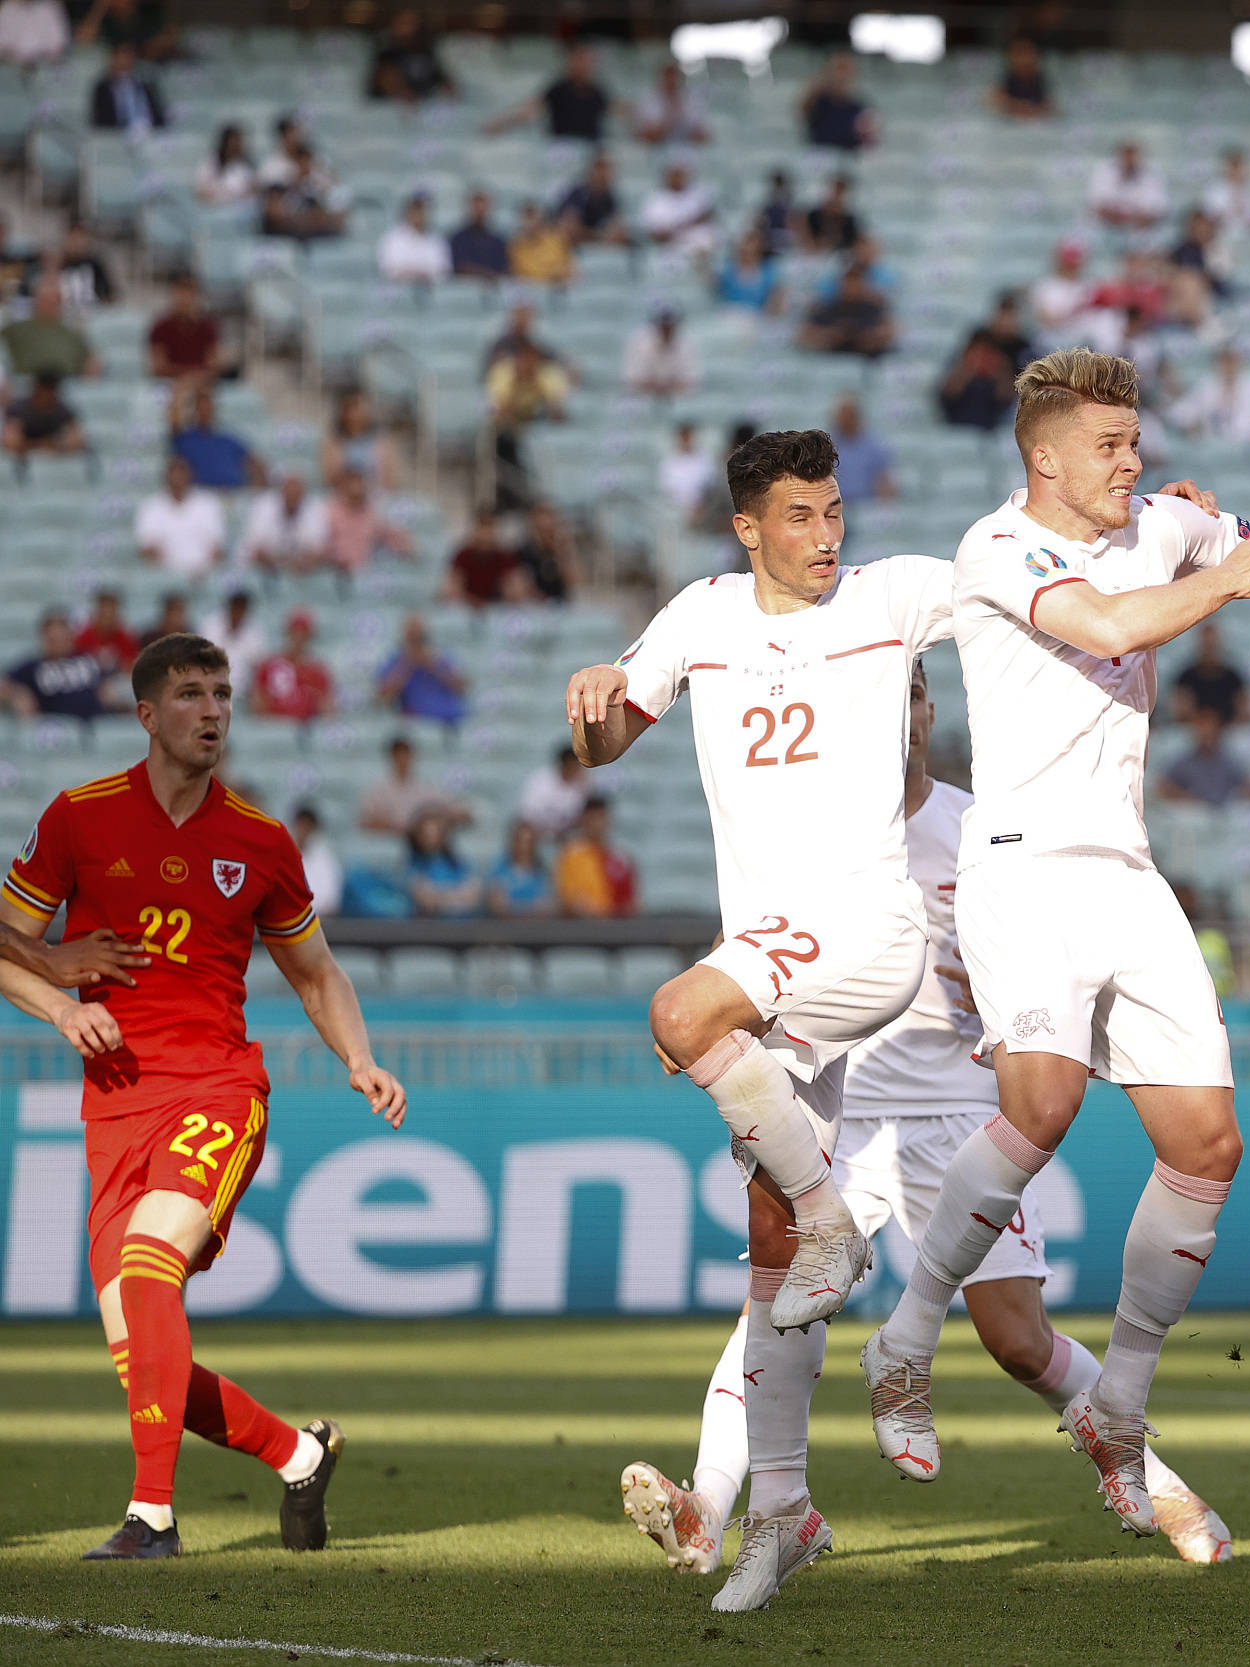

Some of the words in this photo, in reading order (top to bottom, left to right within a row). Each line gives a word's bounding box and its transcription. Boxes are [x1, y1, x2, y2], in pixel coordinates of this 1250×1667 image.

[742, 702, 819, 767] 22
[138, 905, 192, 964] 22
[734, 915, 820, 980] 22
[168, 1113, 235, 1171] 22
